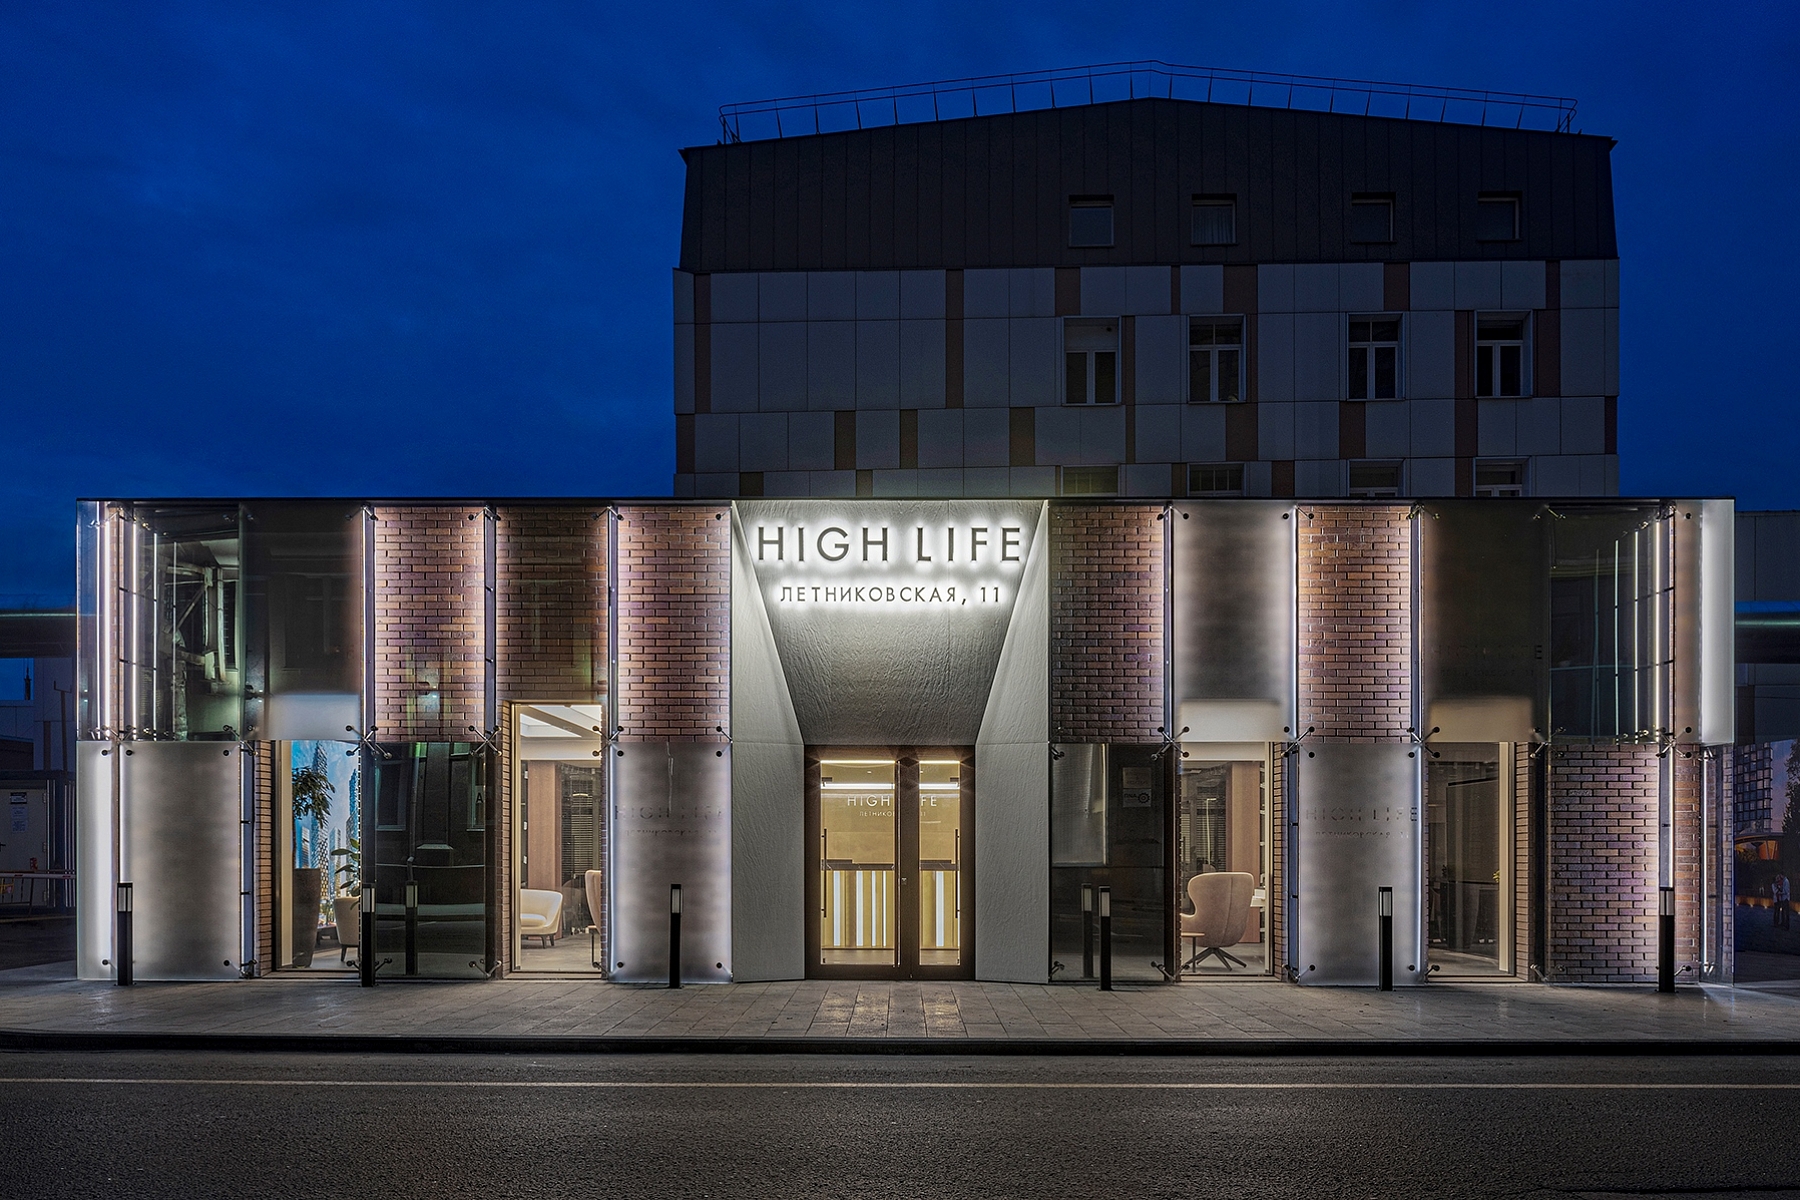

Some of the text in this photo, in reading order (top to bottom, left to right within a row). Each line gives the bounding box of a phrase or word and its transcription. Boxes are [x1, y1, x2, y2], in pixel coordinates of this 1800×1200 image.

[758, 526, 1021, 562] HIGH LIFE
[780, 586, 1000, 605] ЛЕТНИКОВСКАЯ, 11
[848, 795, 890, 807] HIGH
